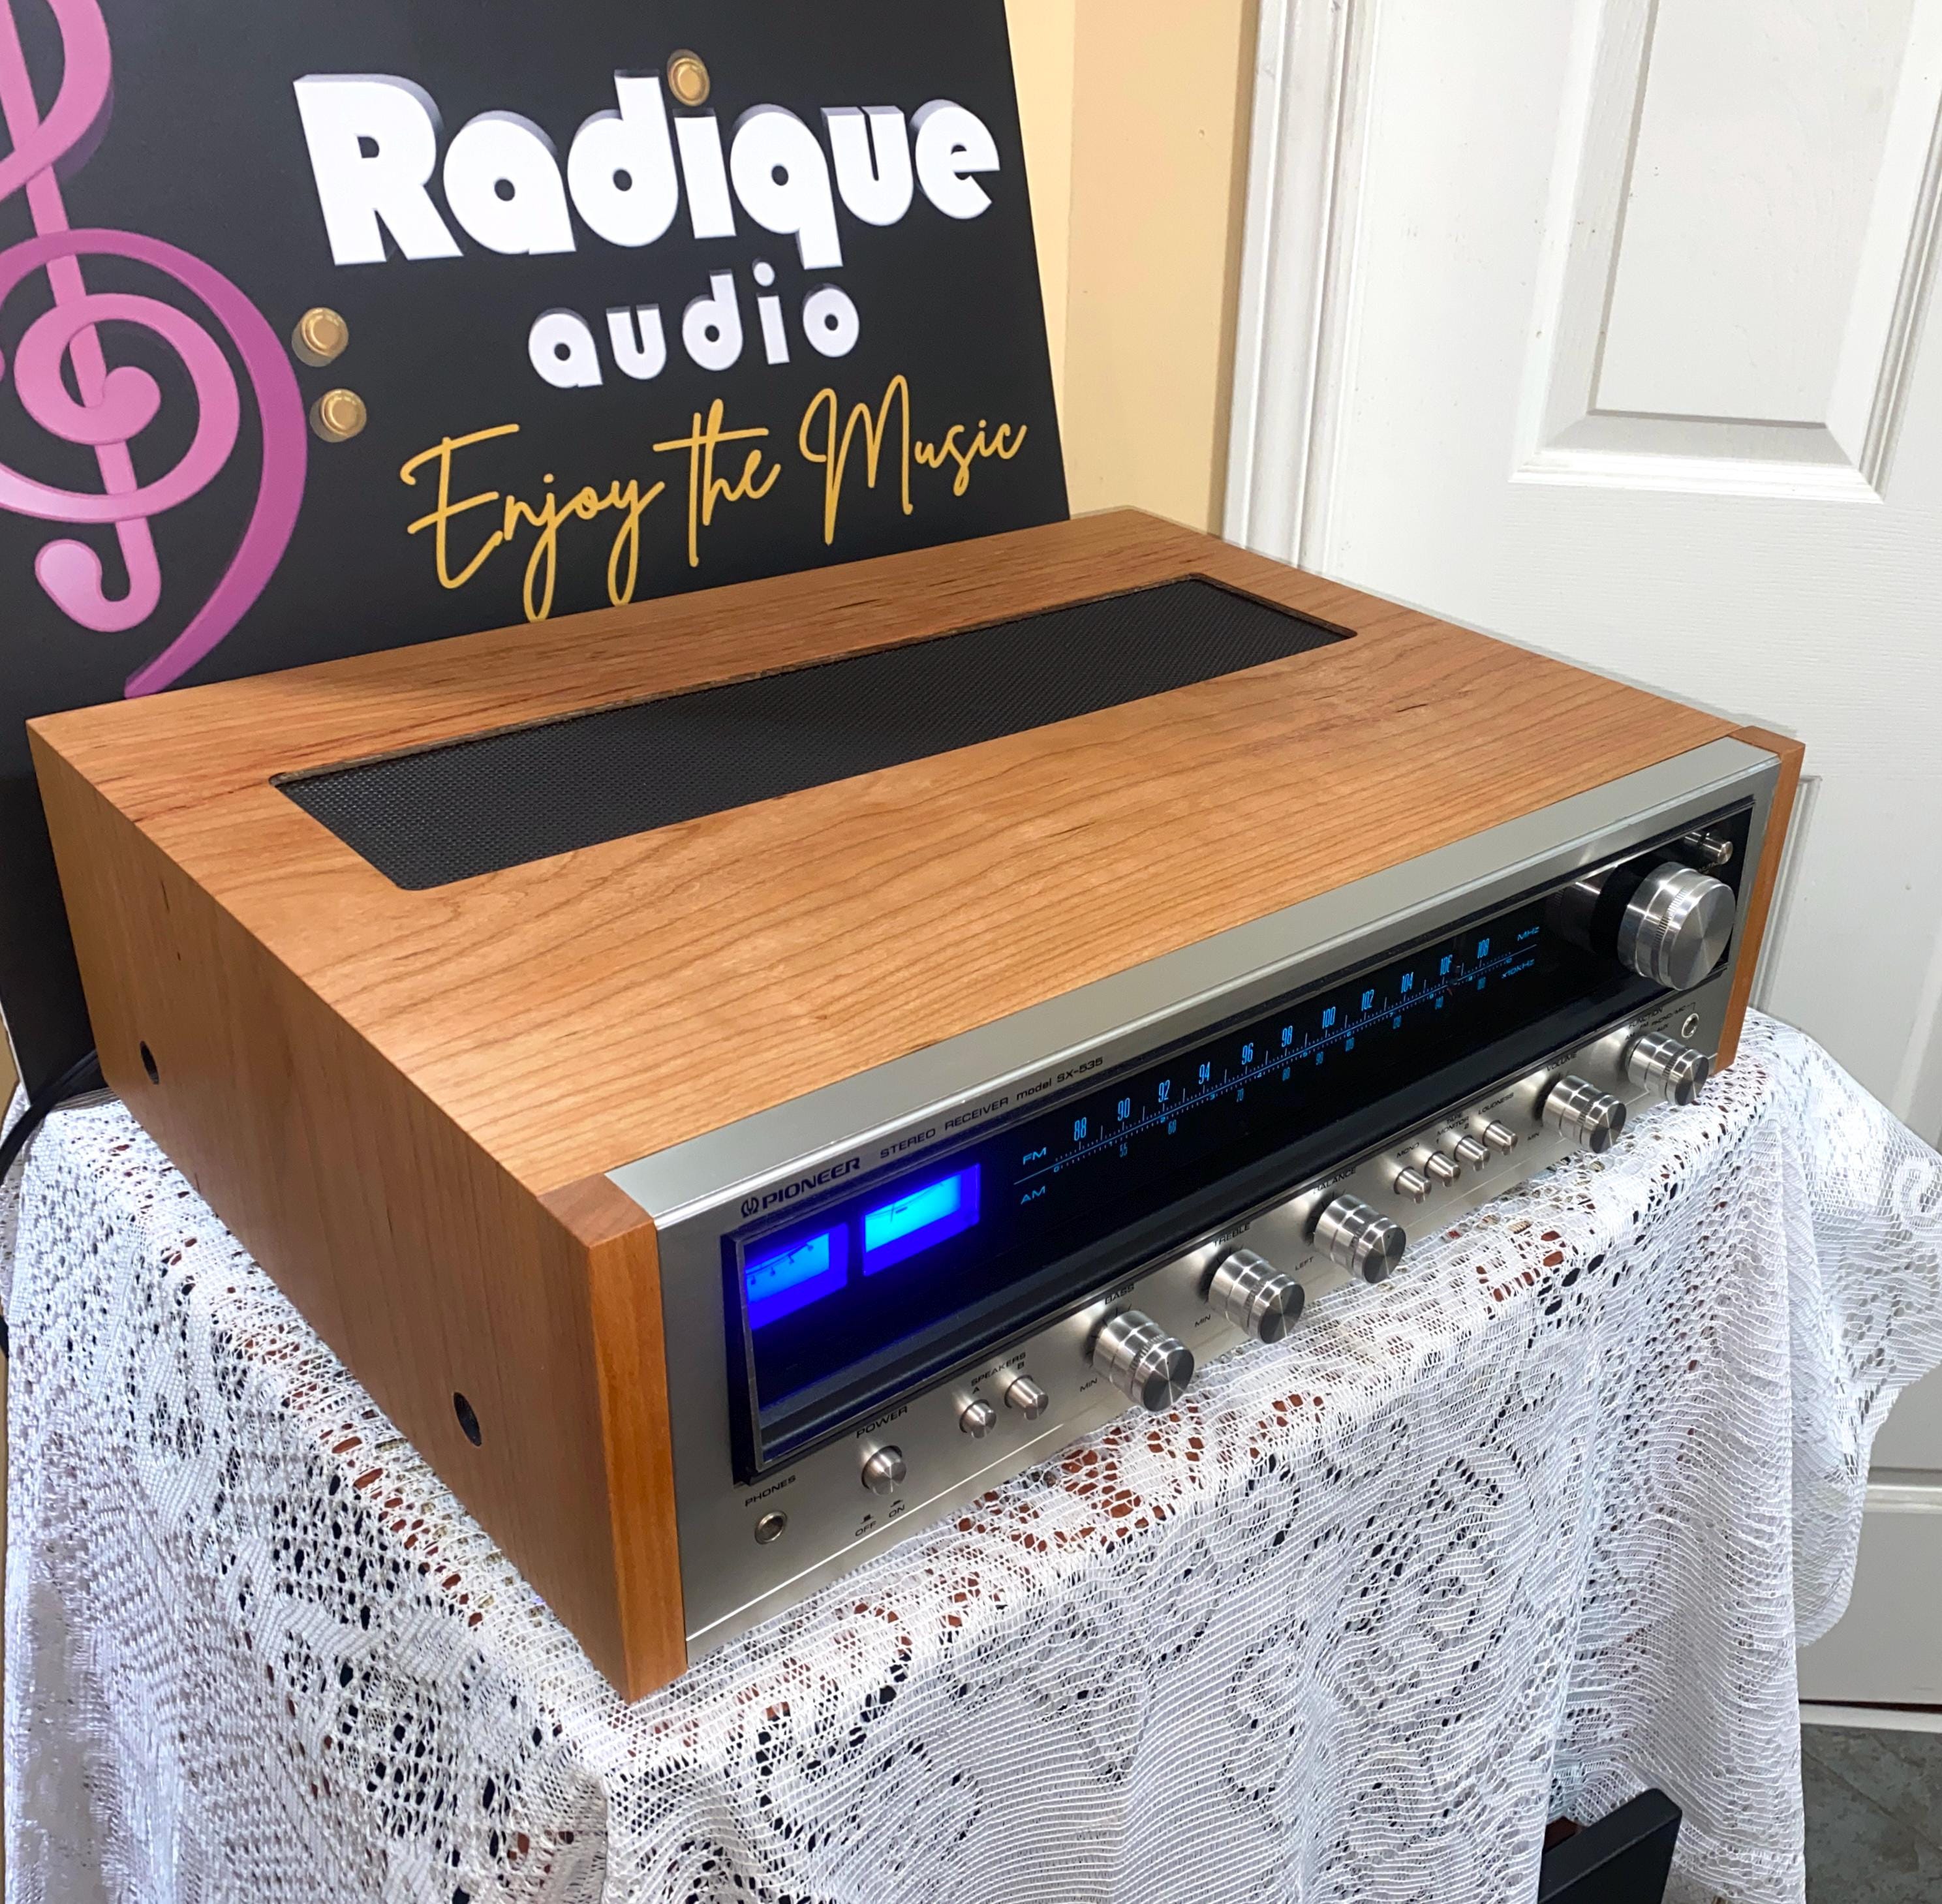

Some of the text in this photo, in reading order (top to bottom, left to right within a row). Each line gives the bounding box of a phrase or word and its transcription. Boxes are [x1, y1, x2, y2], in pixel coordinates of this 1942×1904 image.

[293, 50, 1001, 269] Radique
[528, 261, 860, 388] audio
[400, 375, 1027, 622] Enjoy the Music
[1023, 1147, 1047, 1165] FM
[1074, 1117, 1087, 1141] 88
[1117, 1098, 1130, 1122] 90
[1158, 1079, 1171, 1103] 92
[1199, 1061, 1210, 1084] 94
[1242, 1043, 1254, 1065] 96
[1281, 1025, 1293, 1047] 98
[1322, 1006, 1336, 1029] 100
[1361, 989, 1375, 1011] 102
[1401, 972, 1414, 993] 104
[1477, 1092, 1515, 1115] LOUDNESS
[762, 1056, 1103, 1210] PIONEER STEREO RECEIVER model SX-535
[1020, 1186, 1046, 1205] AM
[1119, 1143, 1128, 1158] 55
[1237, 1088, 1244, 1103] 70
[1396, 1142, 1420, 1158] MONO
[1313, 1167, 1357, 1195] BALANCE
[1213, 1223, 1251, 1247] TREBLE
[1295, 1256, 1314, 1271] LEFT
[1105, 1283, 1135, 1306] BASS
[1194, 1313, 1211, 1328] MIN
[971, 1352, 1026, 1387] SPEAKERS
[1079, 1377, 1098, 1392] MIN
[972, 1387, 980, 1395] A
[856, 1405, 908, 1439] POWER
[745, 1475, 796, 1507] PHONES
[855, 1505, 906, 1537] OFF ON
